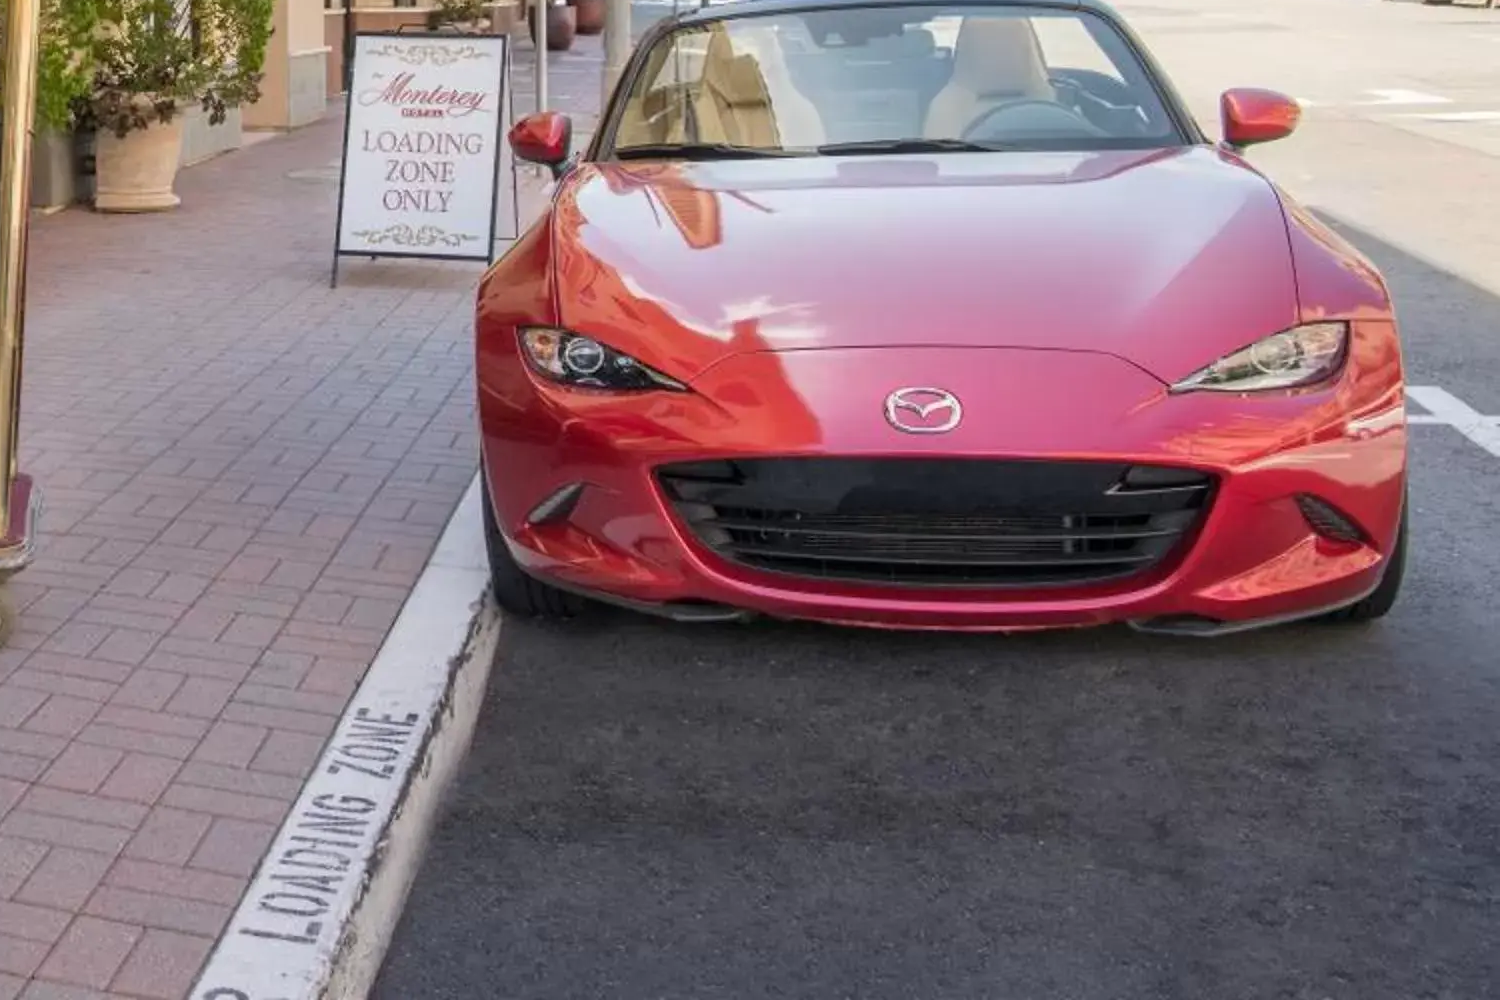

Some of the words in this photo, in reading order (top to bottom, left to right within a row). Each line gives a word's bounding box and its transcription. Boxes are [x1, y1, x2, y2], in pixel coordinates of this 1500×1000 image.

[357, 71, 493, 118] Monterey
[362, 129, 485, 156] LOADING
[384, 159, 456, 184] ZONE
[382, 189, 454, 213] ONLY
[238, 793, 378, 945] LOADING
[327, 707, 420, 780] ZONE
